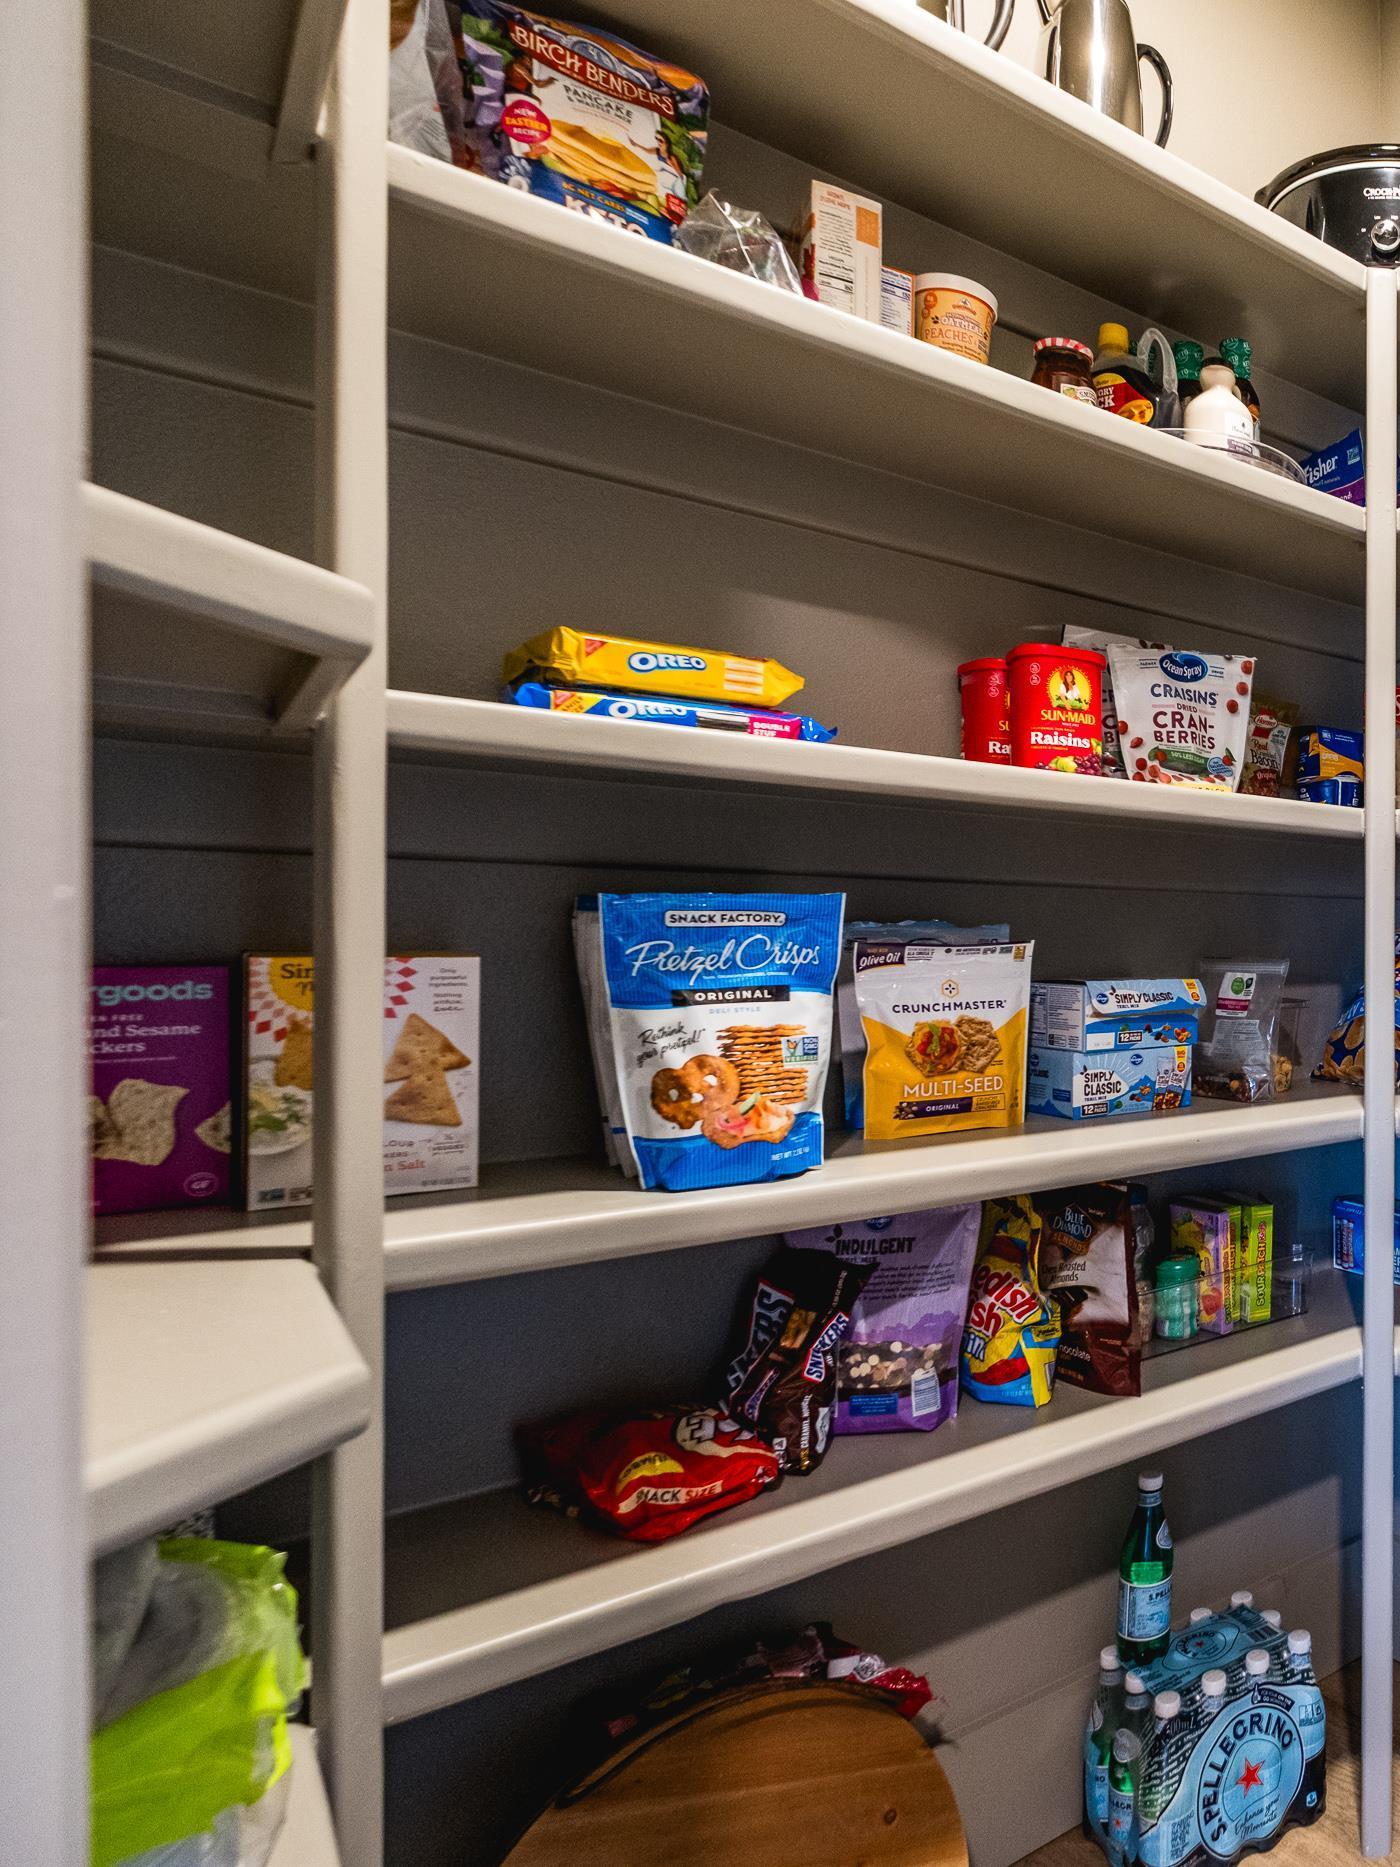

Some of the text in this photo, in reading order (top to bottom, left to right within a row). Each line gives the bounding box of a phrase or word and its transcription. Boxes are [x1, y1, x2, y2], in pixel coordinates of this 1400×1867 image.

[510, 24, 676, 116] BIRCH BENDERS
[563, 84, 633, 119] PANCAKE
[925, 328, 973, 345] PEACHES
[1304, 454, 1339, 485] Fisher
[629, 652, 706, 672] OREO
[1162, 659, 1202, 679] Ocean Spray
[1150, 683, 1217, 706] CRAISINS
[609, 702, 688, 719] OREO
[1177, 702, 1197, 713] DRIED
[1041, 709, 1095, 725] SUN-MAID
[1152, 711, 1215, 735] CRAN-
[753, 721, 791, 733] DOUBLE
[1030, 731, 1091, 749] Raisins
[1154, 730, 1216, 750] BERRIES
[669, 913, 717, 925] SNACK
[625, 934, 820, 986] Pretzel Crisps
[859, 955, 885, 970] Olive
[886, 951, 900, 964] Oil
[694, 989, 772, 1001] ORIGINAL
[1115, 992, 1174, 1004] SIMPLY CLASSIC
[892, 1000, 1005, 1014] CRUNCHMASTER
[125, 1024, 201, 1037] Sesame
[637, 1021, 688, 1047] Rethink
[1120, 1034, 1130, 1042] 12
[1084, 1071, 1114, 1083] SIMPLY
[904, 1076, 1003, 1098] MULTI-SEED
[1084, 1082, 1121, 1096] CLASSIC
[926, 1104, 959, 1112] ORIGINAL
[1083, 1106, 1093, 1114] 12
[398, 1158, 426, 1172] Salt
[1065, 1207, 1085, 1225] BLUE
[1053, 1216, 1092, 1239] DIAMOND
[835, 1237, 915, 1256] INDULGENT
[1059, 1261, 1086, 1272] Roasted
[973, 1264, 1042, 1324] edish
[1256, 1276, 1265, 1306] SOUR
[804, 1313, 849, 1382] SNICKERS
[1202, 1713, 1294, 1843] S.PELLEGRINO
